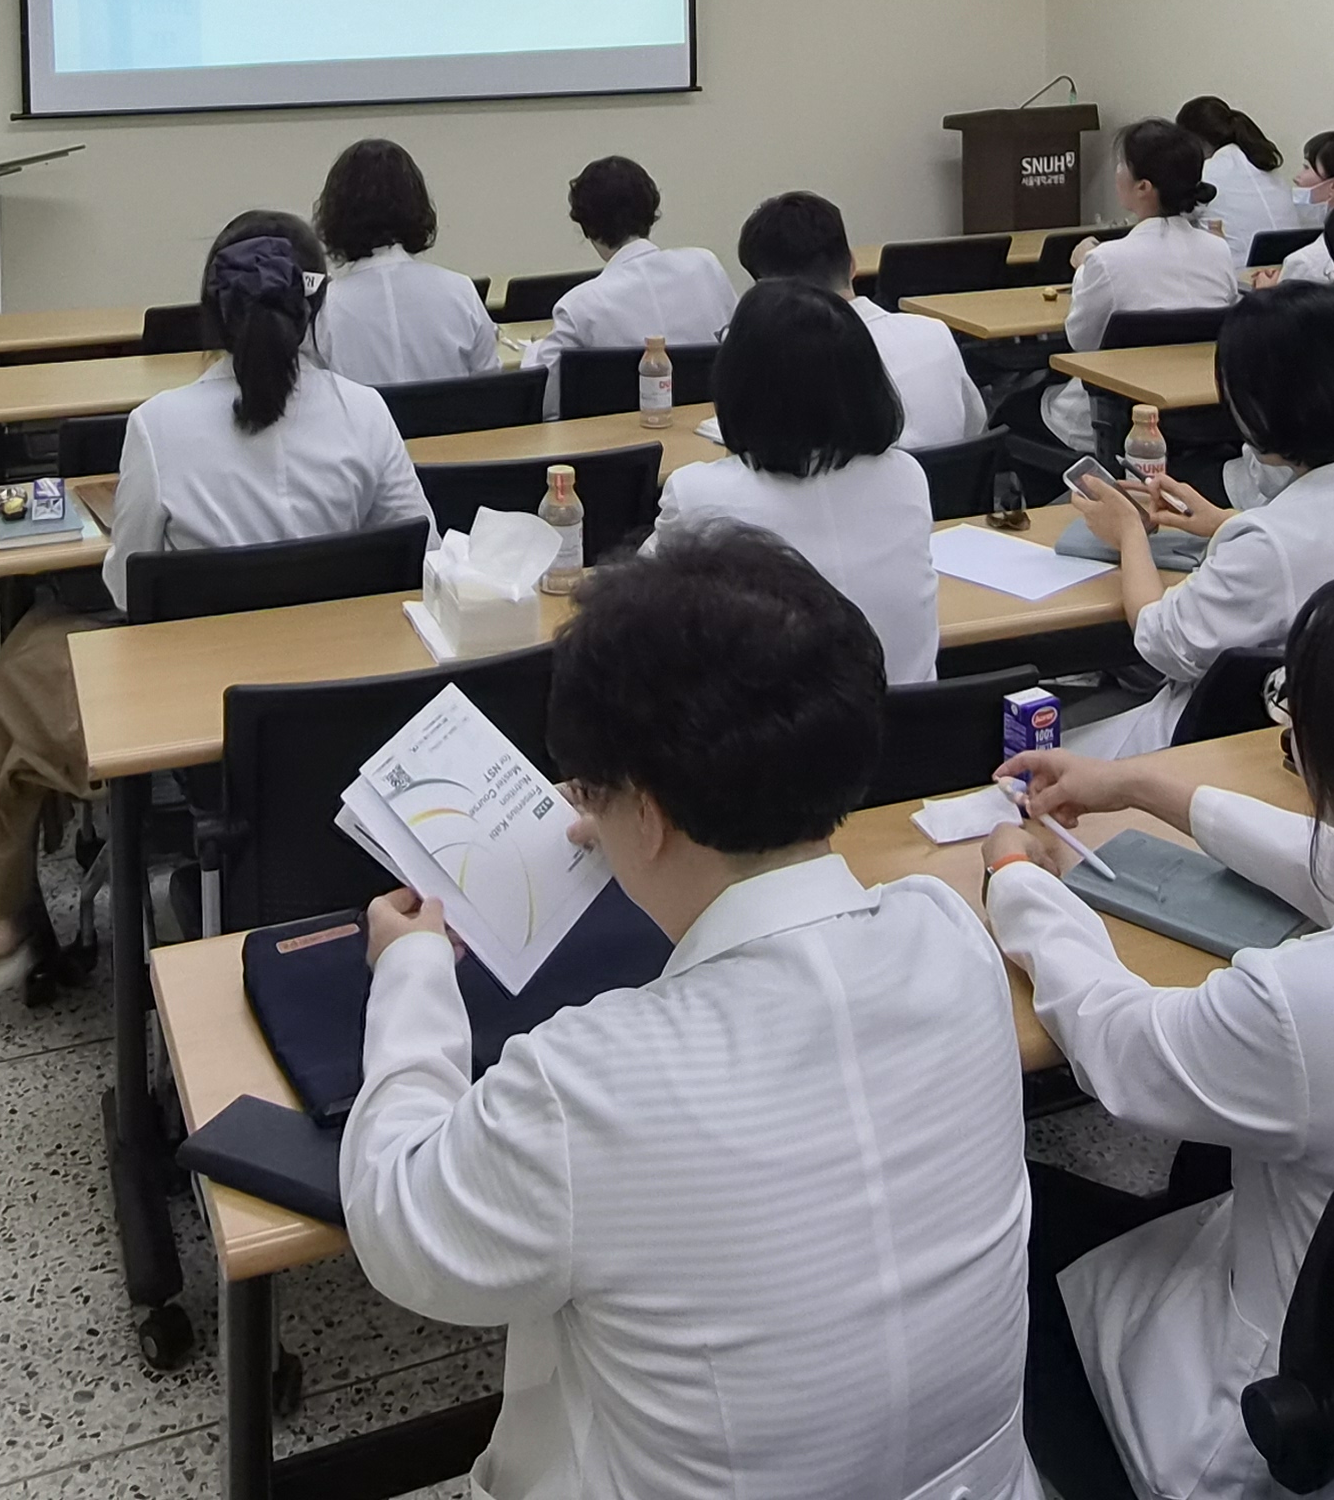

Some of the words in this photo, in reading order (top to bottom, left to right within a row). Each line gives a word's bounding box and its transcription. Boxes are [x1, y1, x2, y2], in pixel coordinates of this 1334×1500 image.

[1021, 155, 1065, 175] SNUH
[483, 763, 502, 783] NST
[495, 764, 522, 790] Master
[468, 788, 497, 818] Course
[499, 774, 532, 806] Nutrition
[506, 785, 543, 821] Fresenius
[489, 819, 510, 840] Kabi
